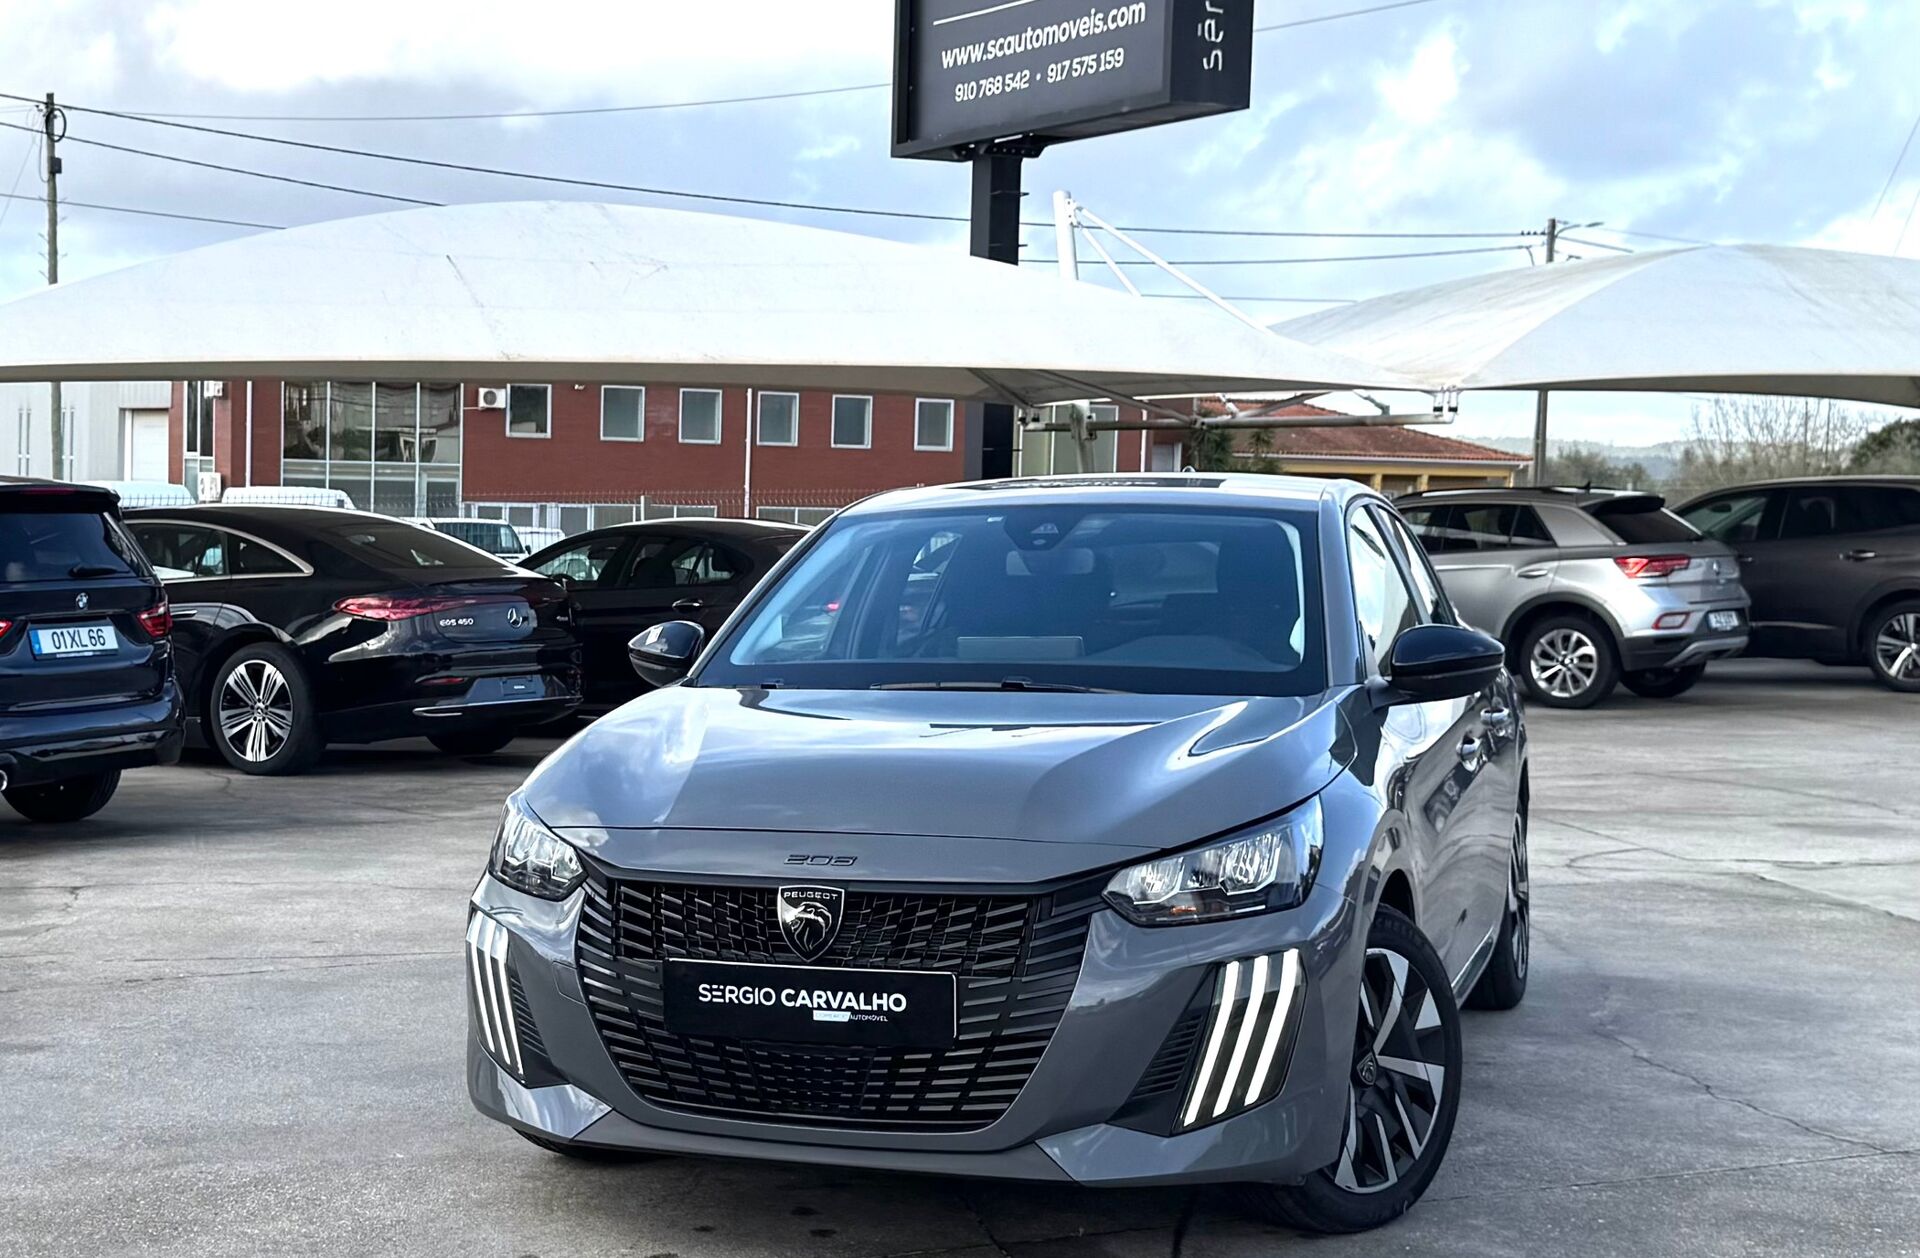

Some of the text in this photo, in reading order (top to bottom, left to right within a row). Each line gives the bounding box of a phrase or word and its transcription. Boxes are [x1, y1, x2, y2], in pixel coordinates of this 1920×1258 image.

[941, 1, 1146, 69] www.scautomoveis.com
[955, 47, 1125, 102] 910 768 542 917 575 159
[783, 854, 858, 867] 208
[783, 891, 839, 900] PEUGEOT
[780, 989, 907, 1012] CARVALHO
